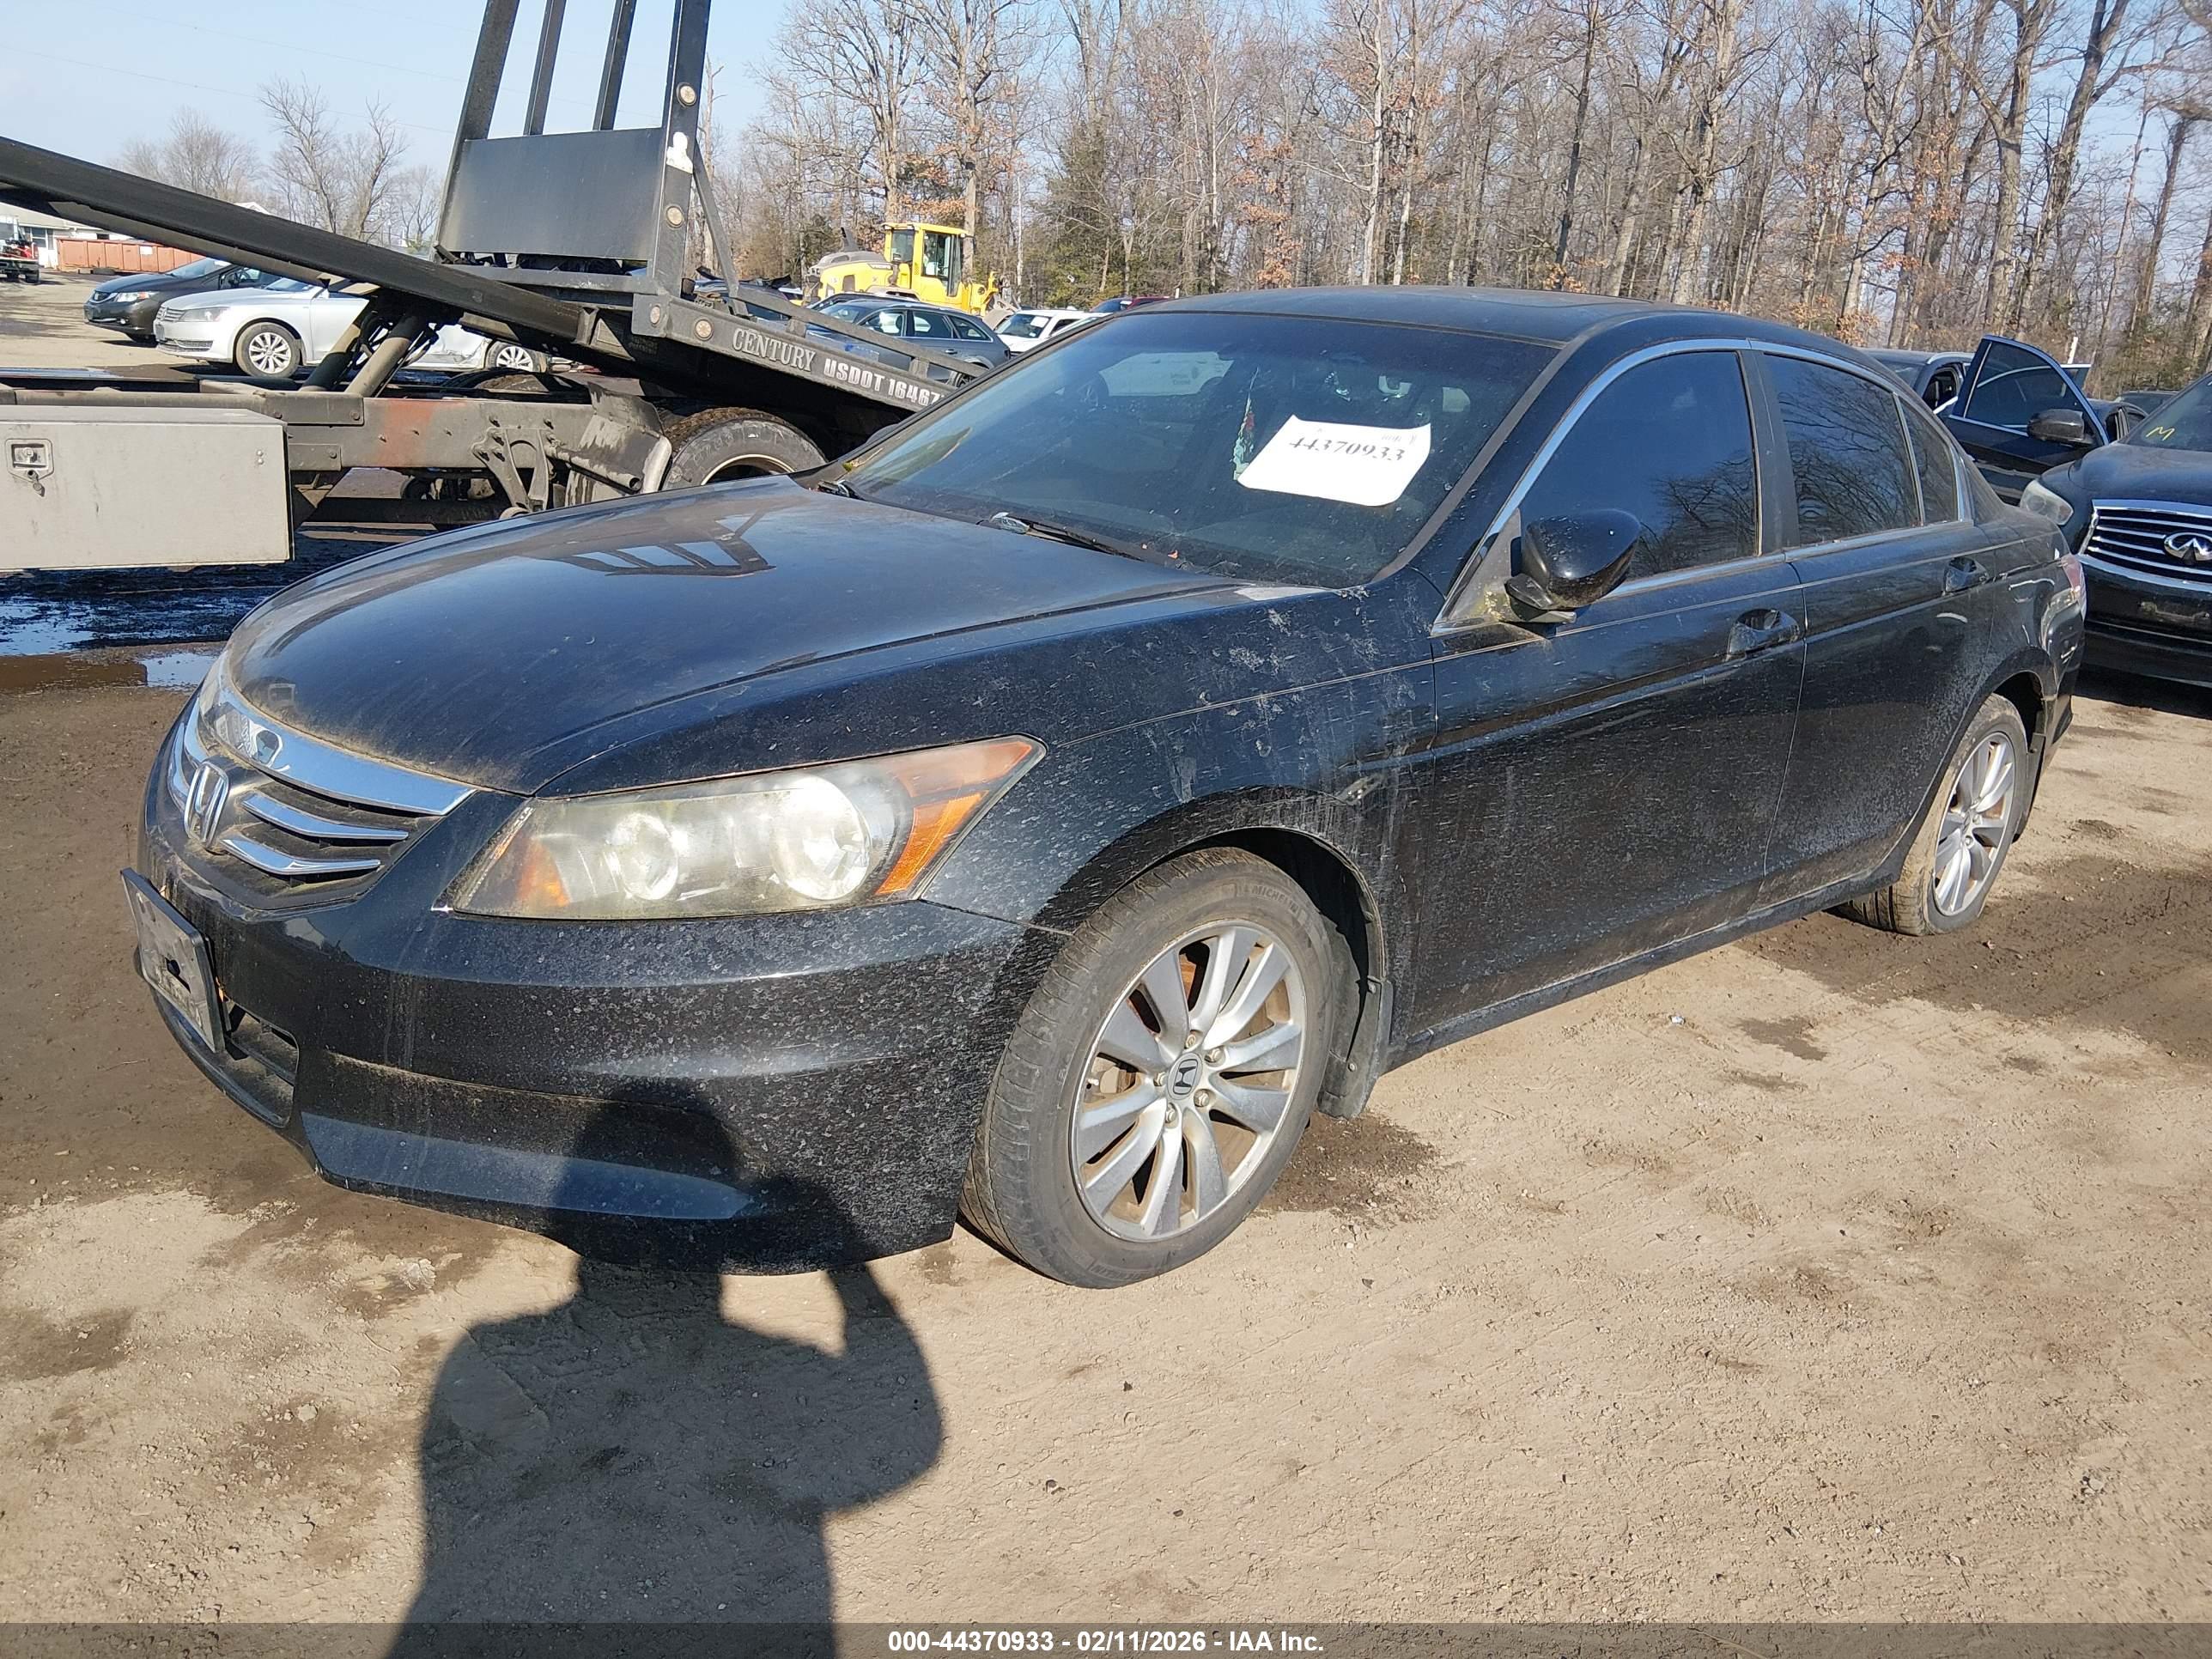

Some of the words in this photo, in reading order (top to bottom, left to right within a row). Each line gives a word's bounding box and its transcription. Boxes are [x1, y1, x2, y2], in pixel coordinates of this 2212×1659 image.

[732, 328, 816, 372] CENTURY
[823, 358, 884, 392] USDOT
[888, 379, 945, 407] 16467
[1290, 437, 1405, 461] 44370933
